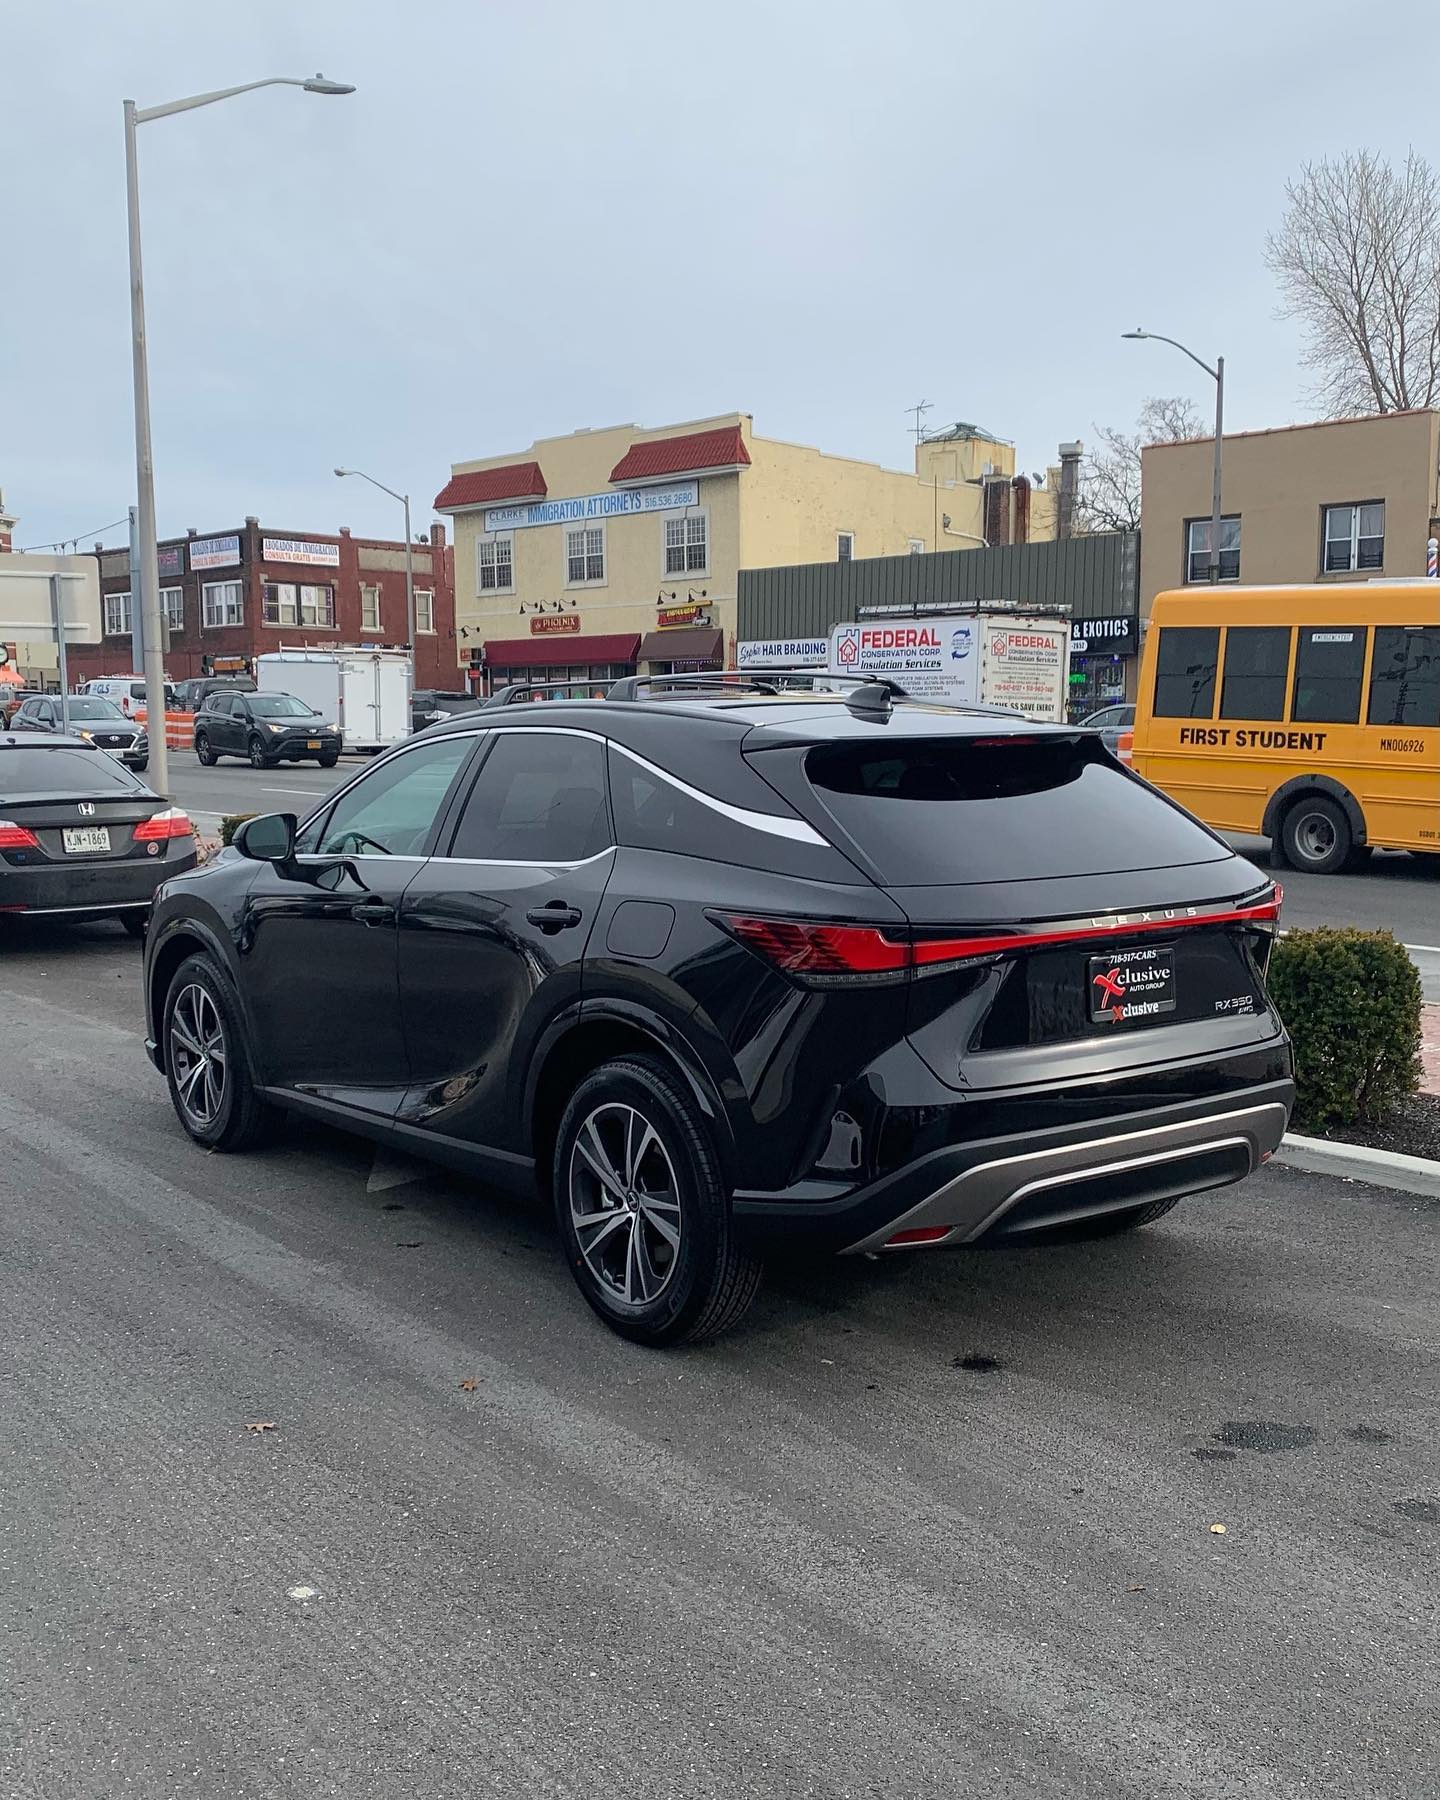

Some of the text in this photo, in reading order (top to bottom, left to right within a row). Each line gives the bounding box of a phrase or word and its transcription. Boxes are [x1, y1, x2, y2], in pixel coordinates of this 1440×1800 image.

[489, 491, 692, 523] CLARKE IMMIGRATION ATTORNEYS 516.536.2680
[265, 551, 291, 560] CONSULTA
[542, 616, 575, 628] PHOENIX
[1073, 619, 1129, 638] & EXOTICS
[861, 628, 941, 648] FEDERAL
[1008, 635, 1058, 649] FEDERAL
[762, 644, 782, 656] HAIR
[784, 642, 826, 655] BRAIDING
[861, 648, 942, 658] CONSERVATION CORP.
[860, 658, 942, 670] Insulation Services
[1007, 655, 1035, 663] Insulation
[1020, 703, 1035, 711] SAVE
[1036, 703, 1055, 712] ENERGY
[1180, 728, 1327, 750] FIRST STUDENT
[1380, 738, 1424, 753] MN006926
[1091, 907, 1197, 927] LEXUS
[1110, 950, 1157, 965] 718-517-CARS
[1093, 966, 1171, 1009] Xclusive
[1129, 982, 1165, 992] AUTO GROUP
[1238, 1005, 1253, 1015] AWD
